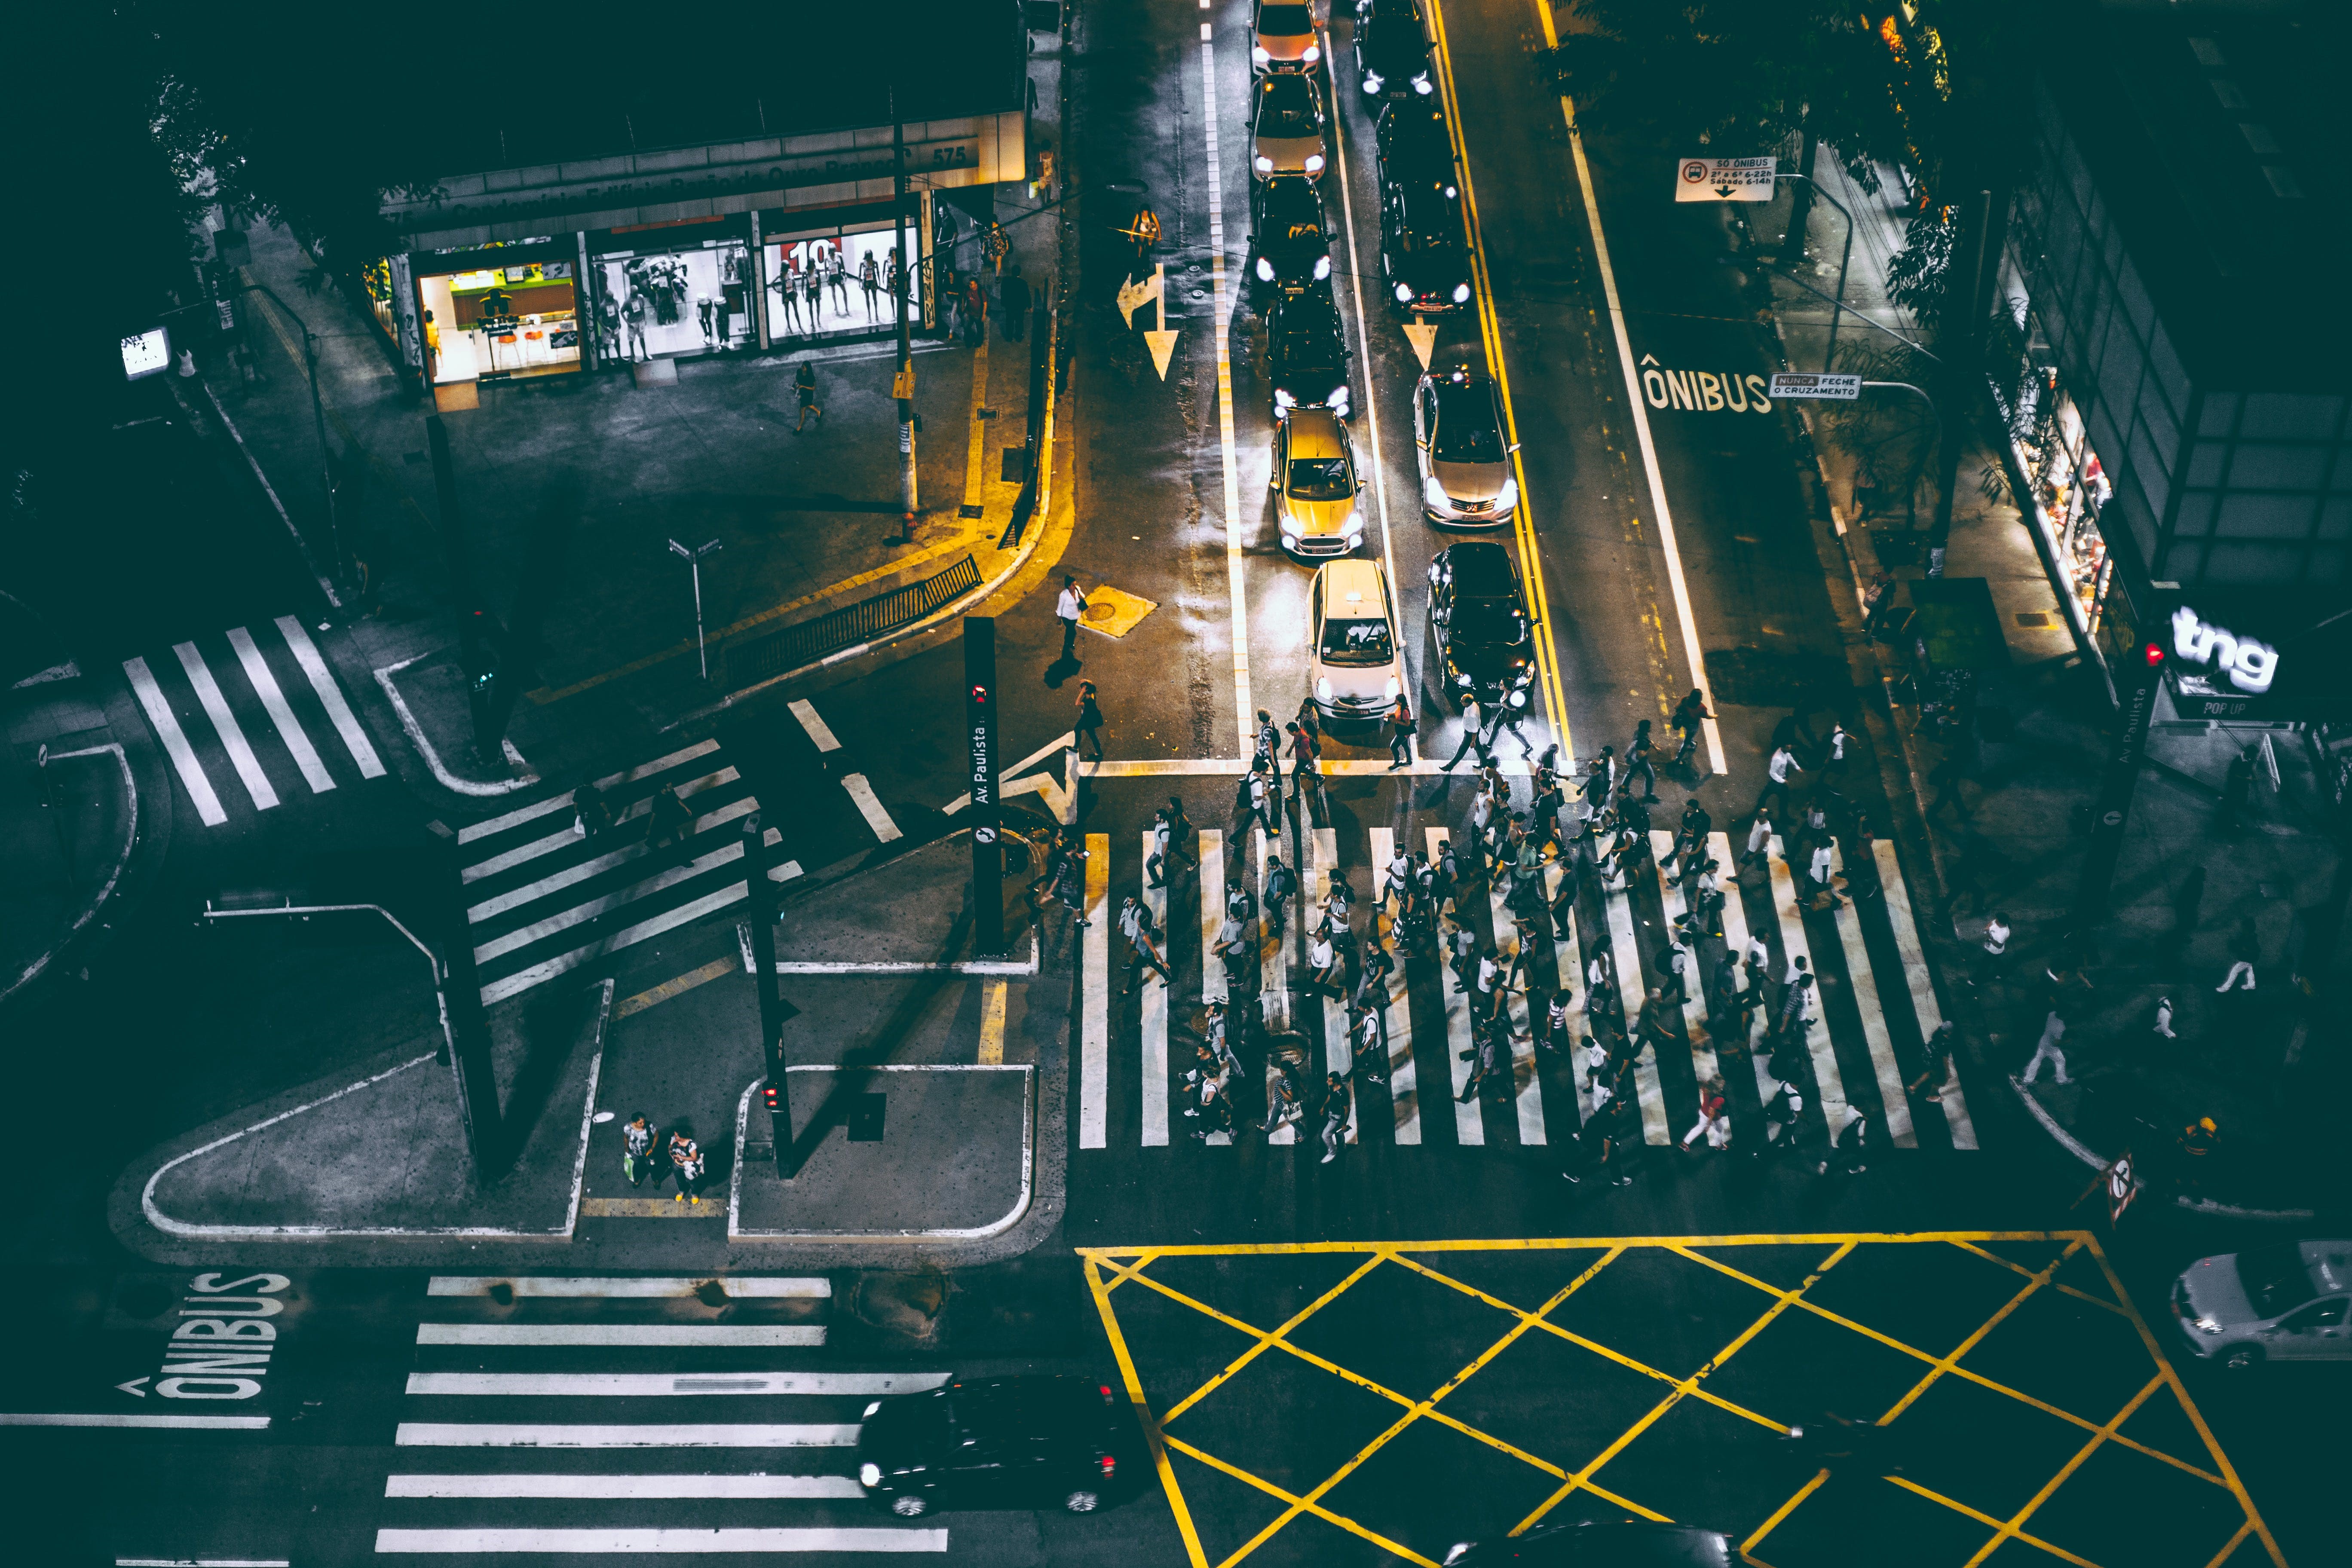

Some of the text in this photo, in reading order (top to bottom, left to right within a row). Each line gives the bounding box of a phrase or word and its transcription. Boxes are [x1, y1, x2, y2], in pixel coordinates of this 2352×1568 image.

[934, 147, 966, 166] 575
[1717, 159, 1729, 167] SÓ
[671, 175, 730, 197] Barão
[769, 167, 818, 185] Ouro
[790, 239, 830, 273] 10
[1640, 353, 1772, 413] ÔNIBUS
[1785, 387, 1855, 395] CRUZAMENTO
[2172, 606, 2279, 693] tng
[2123, 688, 2146, 743] Paulista
[2203, 702, 2247, 715] POP UP
[973, 727, 987, 782] Paulista
[975, 785, 989, 804] Av.
[113, 1273, 291, 1400] ÔNIBUS
